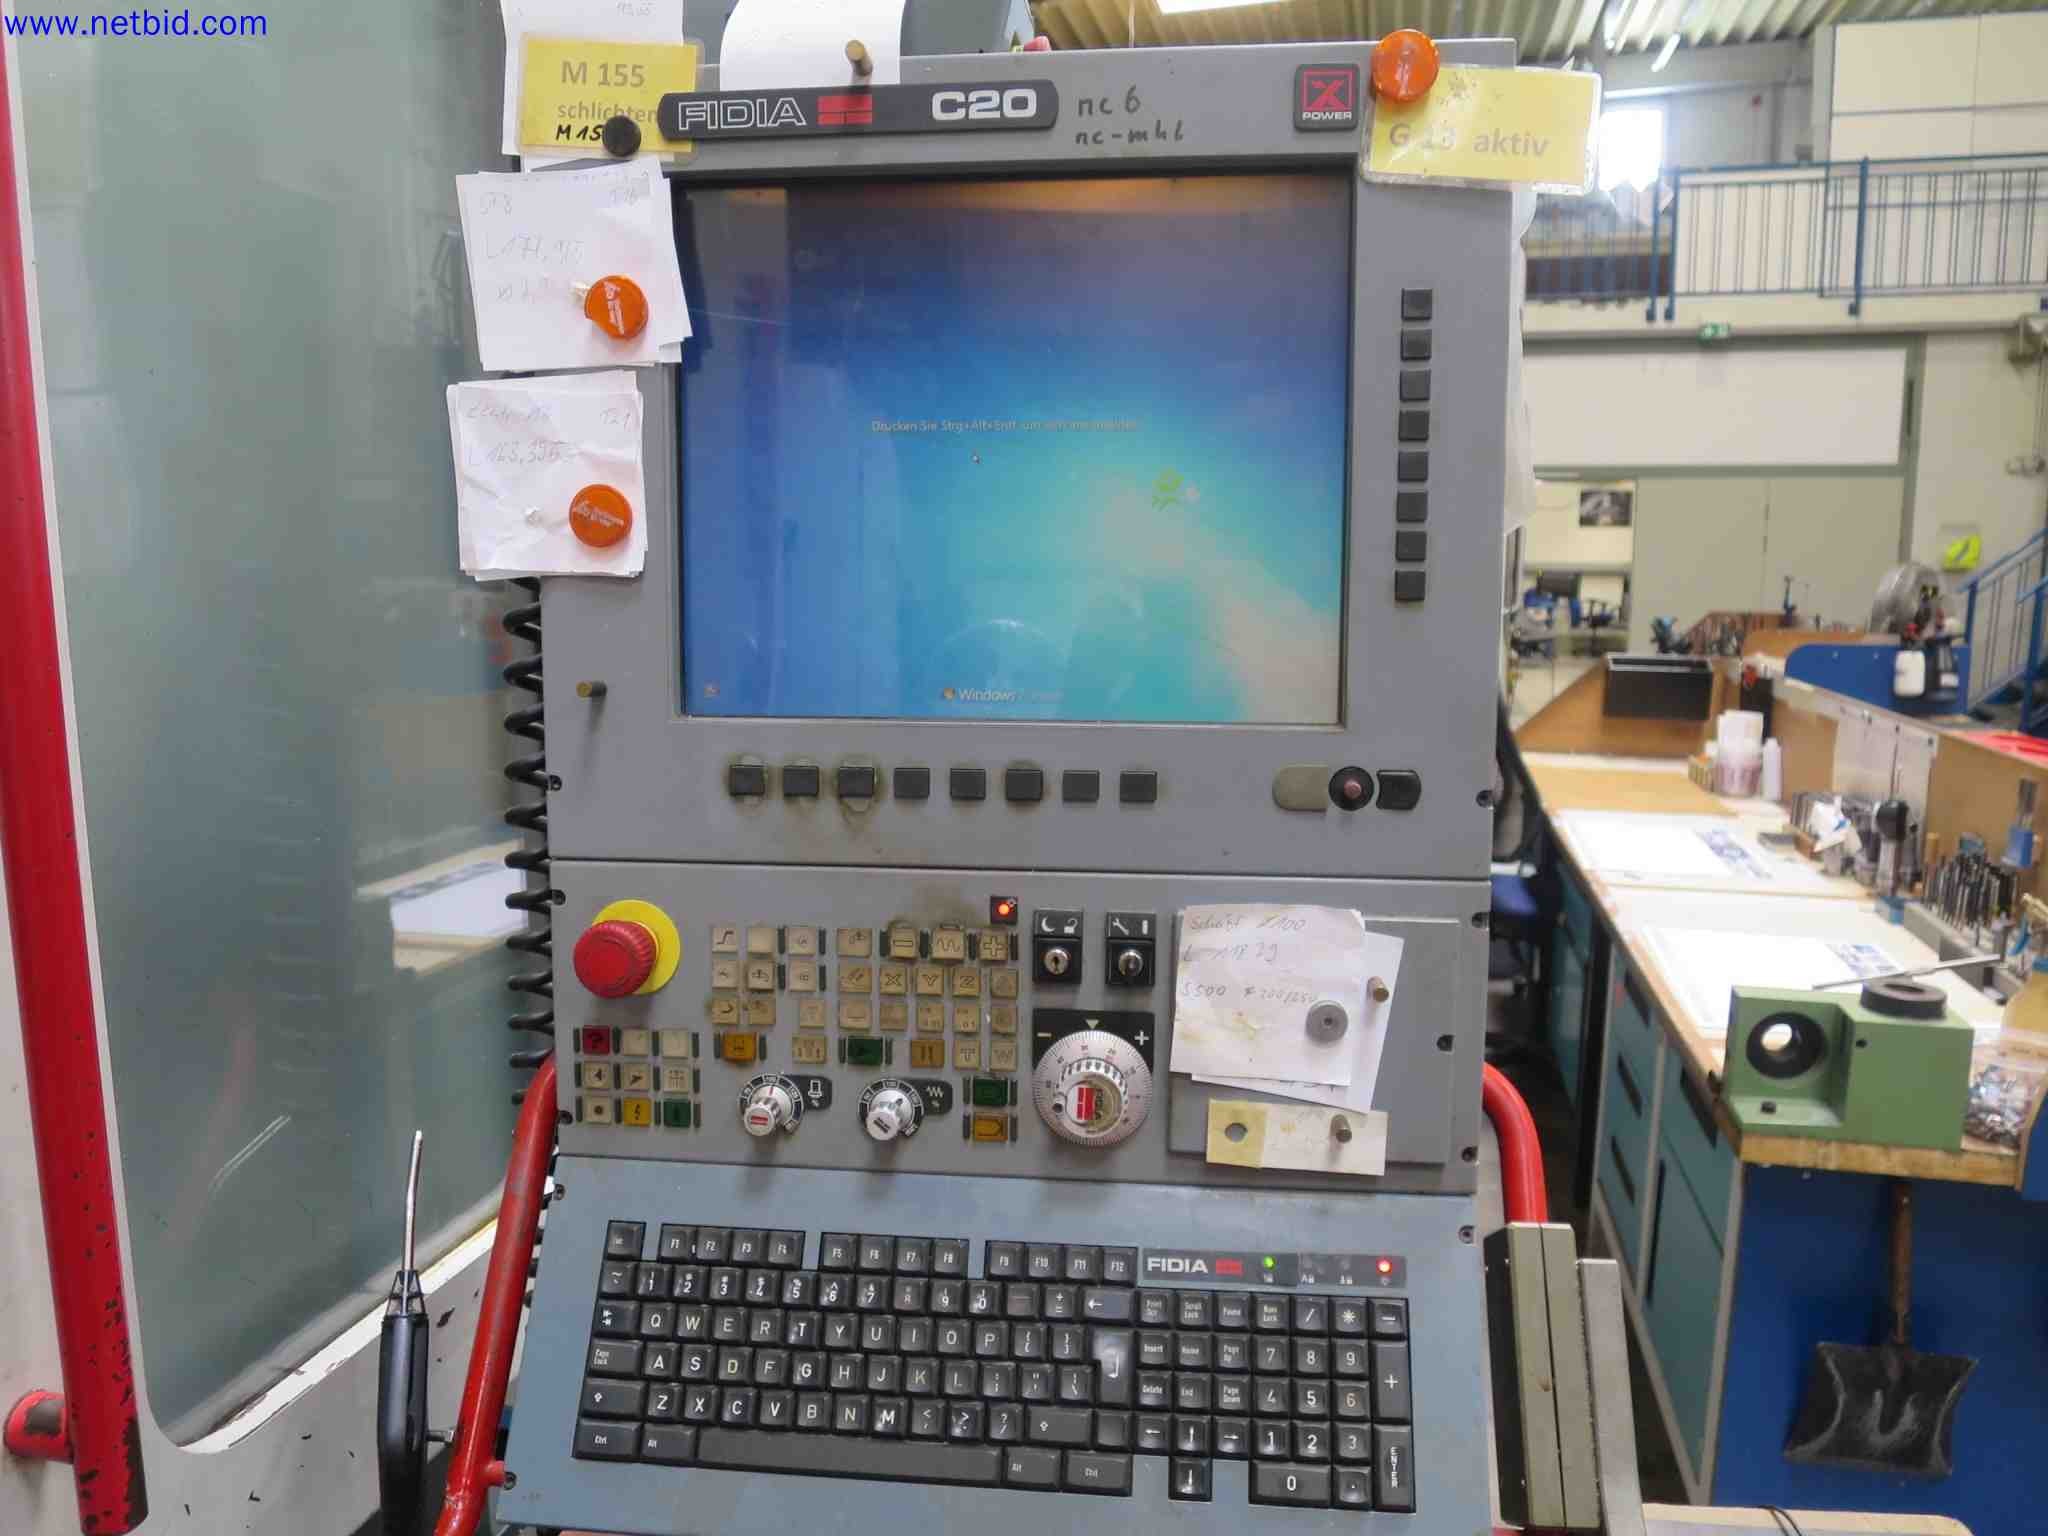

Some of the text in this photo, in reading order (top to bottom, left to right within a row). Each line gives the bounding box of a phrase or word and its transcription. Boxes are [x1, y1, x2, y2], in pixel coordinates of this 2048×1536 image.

[560, 60, 646, 88] M 155
[1078, 84, 1141, 117] nc 6
[678, 88, 1037, 131] FIDIA C20
[1302, 111, 1352, 121] POWER
[555, 124, 572, 141] M
[1390, 123, 1410, 147] G
[1473, 127, 1550, 157] aktiv
[958, 688, 1017, 702] Windows
[885, 974, 902, 986] X
[922, 974, 938, 986] Y
[671, 1238, 680, 1249] F1
[706, 1240, 716, 1251] F2
[742, 1243, 752, 1253] F3
[778, 1244, 787, 1255] F4
[832, 1248, 842, 1258] F5
[907, 1251, 916, 1262] F7
[943, 1252, 953, 1264] F8
[1036, 1257, 1049, 1268] F10
[1074, 1260, 1087, 1271] F11
[1111, 1261, 1125, 1273] F12
[1146, 1257, 1208, 1273] FIDIA
[683, 1281, 692, 1293] 2
[720, 1283, 728, 1296] 3
[792, 1287, 800, 1299] 5
[829, 1291, 837, 1302] 6
[866, 1292, 874, 1304] 7
[942, 1296, 950, 1307] 9
[978, 1297, 986, 1310] 0
[650, 1314, 661, 1327] Q
[685, 1315, 700, 1330] W
[723, 1318, 734, 1332] E
[760, 1321, 770, 1335] R
[798, 1322, 807, 1337] T
[835, 1325, 845, 1338] Y
[871, 1327, 881, 1341] U
[946, 1330, 957, 1345] O
[984, 1333, 995, 1347] P
[1144, 1344, 1163, 1353] Insert
[1223, 1345, 1239, 1354] Page
[1266, 1347, 1275, 1362] 7
[653, 1354, 664, 1369] A
[690, 1356, 701, 1371] S
[1306, 1350, 1316, 1365] 8
[1345, 1352, 1355, 1366] 9
[727, 1359, 738, 1373] D
[764, 1361, 776, 1375] F
[801, 1362, 812, 1377] G
[840, 1365, 850, 1380] H
[876, 1367, 886, 1381] J
[915, 1369, 926, 1384] K
[953, 1371, 962, 1387] L
[1223, 1385, 1239, 1395] Page
[1267, 1389, 1276, 1403] 4
[657, 1395, 668, 1410] Z
[695, 1397, 705, 1412] X
[1306, 1390, 1316, 1406] 5
[1346, 1393, 1356, 1408] 6
[732, 1400, 742, 1415] C
[770, 1401, 780, 1417] V
[807, 1404, 817, 1419] B
[845, 1407, 856, 1421] N
[881, 1409, 895, 1424] M
[1307, 1434, 1318, 1450] 2
[1347, 1435, 1357, 1449] 3
[1391, 1446, 1399, 1488] ENTER
[1286, 1475, 1297, 1491] 0
